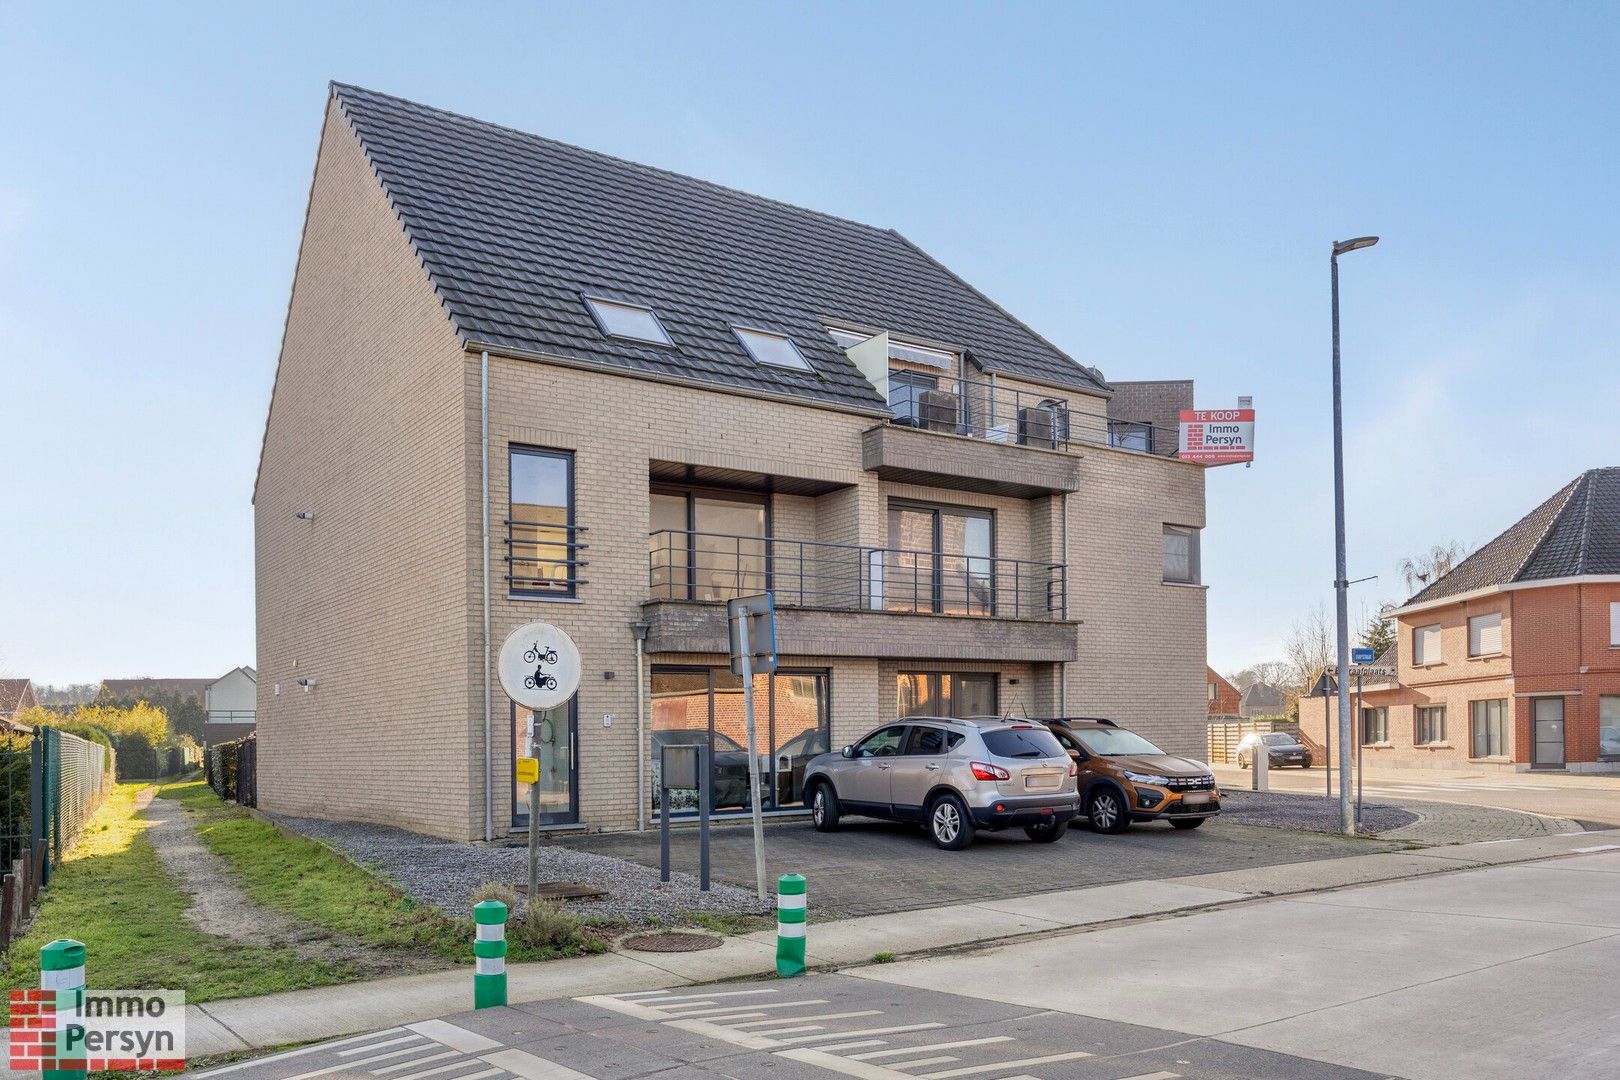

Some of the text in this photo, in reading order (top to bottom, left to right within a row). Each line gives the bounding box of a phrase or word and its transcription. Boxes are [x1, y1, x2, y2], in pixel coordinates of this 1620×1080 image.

[1195, 411, 1240, 421] TE KOOP
[1209, 424, 1240, 433] Immo
[1205, 435, 1242, 446] Persyn
[1335, 666, 1386, 676] Braafplaats
